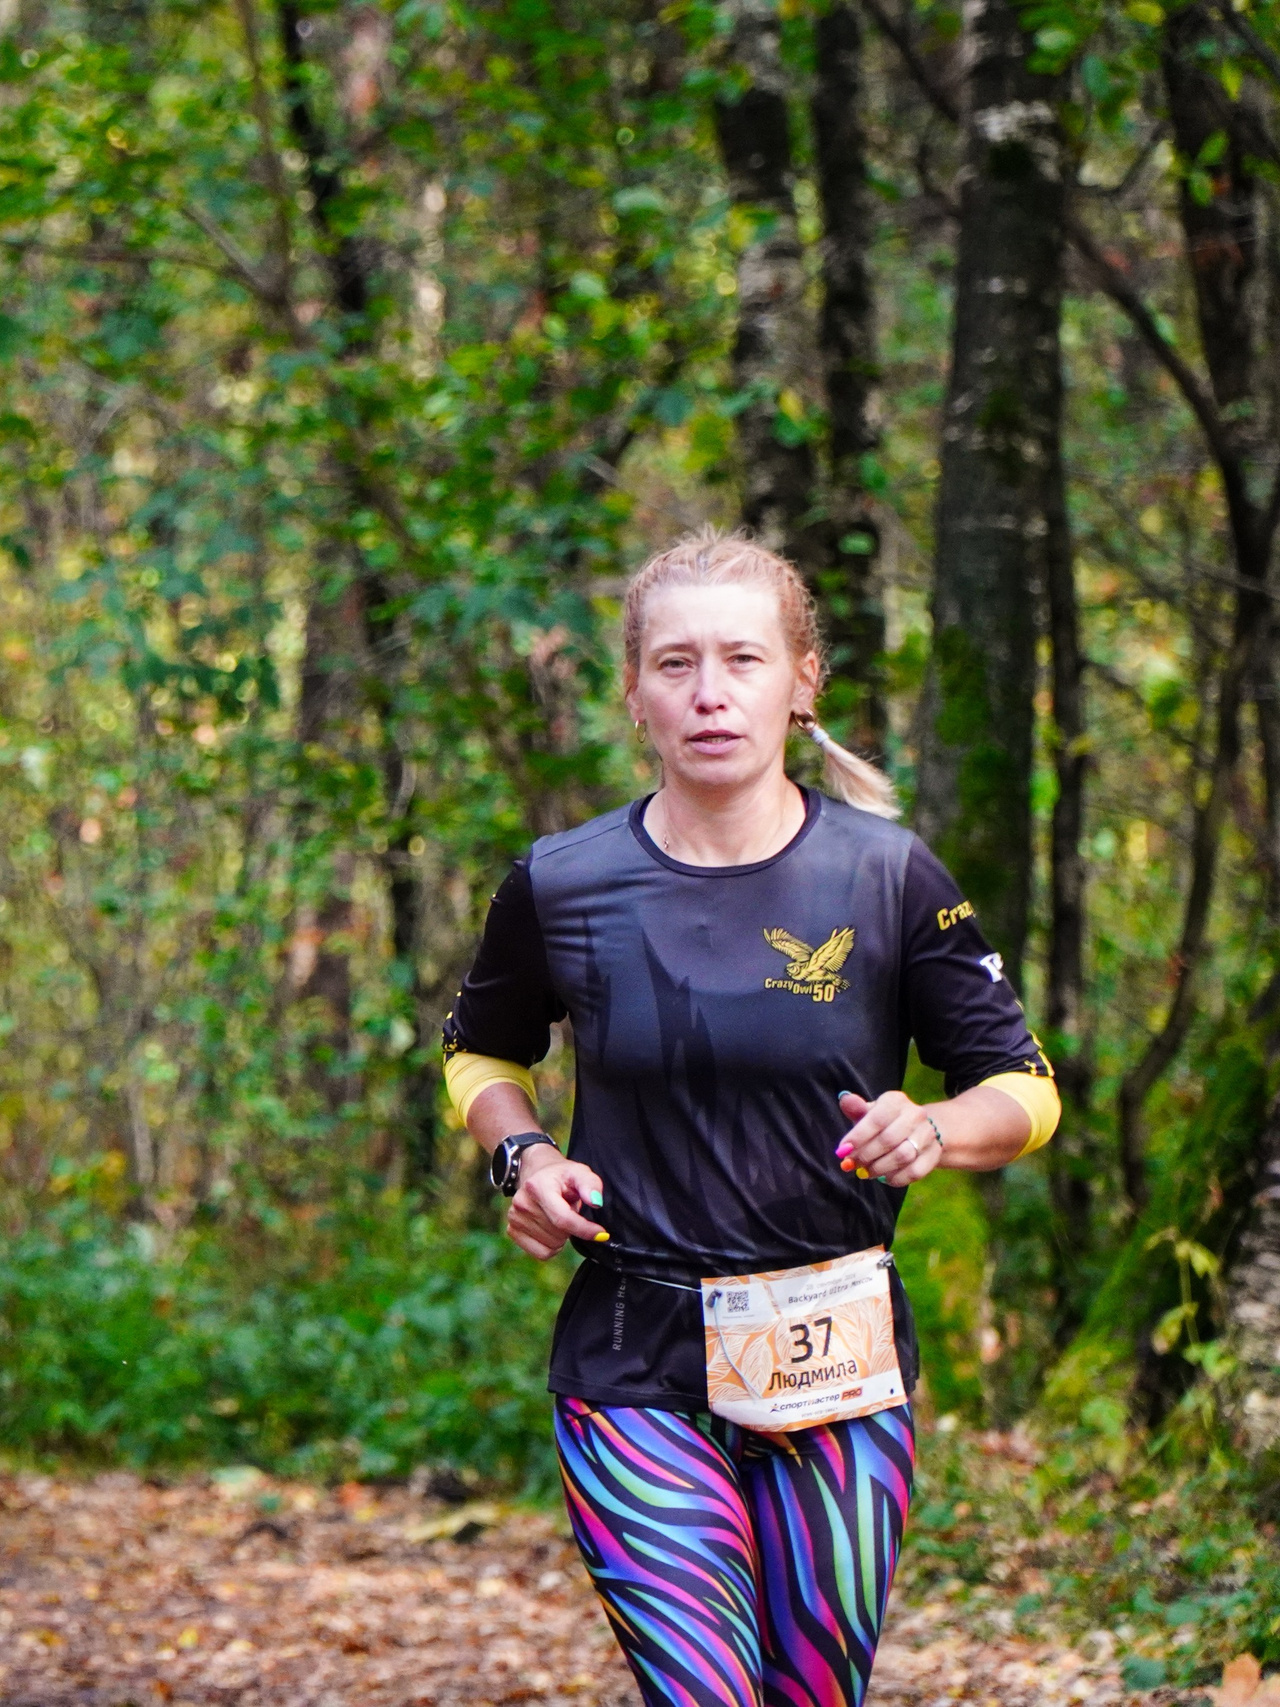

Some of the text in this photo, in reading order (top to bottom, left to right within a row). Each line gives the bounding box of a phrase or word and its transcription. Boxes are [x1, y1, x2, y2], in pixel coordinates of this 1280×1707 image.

[937, 899, 976, 931] Craz
[812, 983, 836, 1003] 50
[788, 1290, 827, 1304] Backyard
[829, 1284, 849, 1295] Ultra
[612, 1302, 626, 1351] RUNNING
[789, 1316, 833, 1364] 37
[768, 1359, 858, 1391] Людмила
[842, 1387, 863, 1400] PRO
